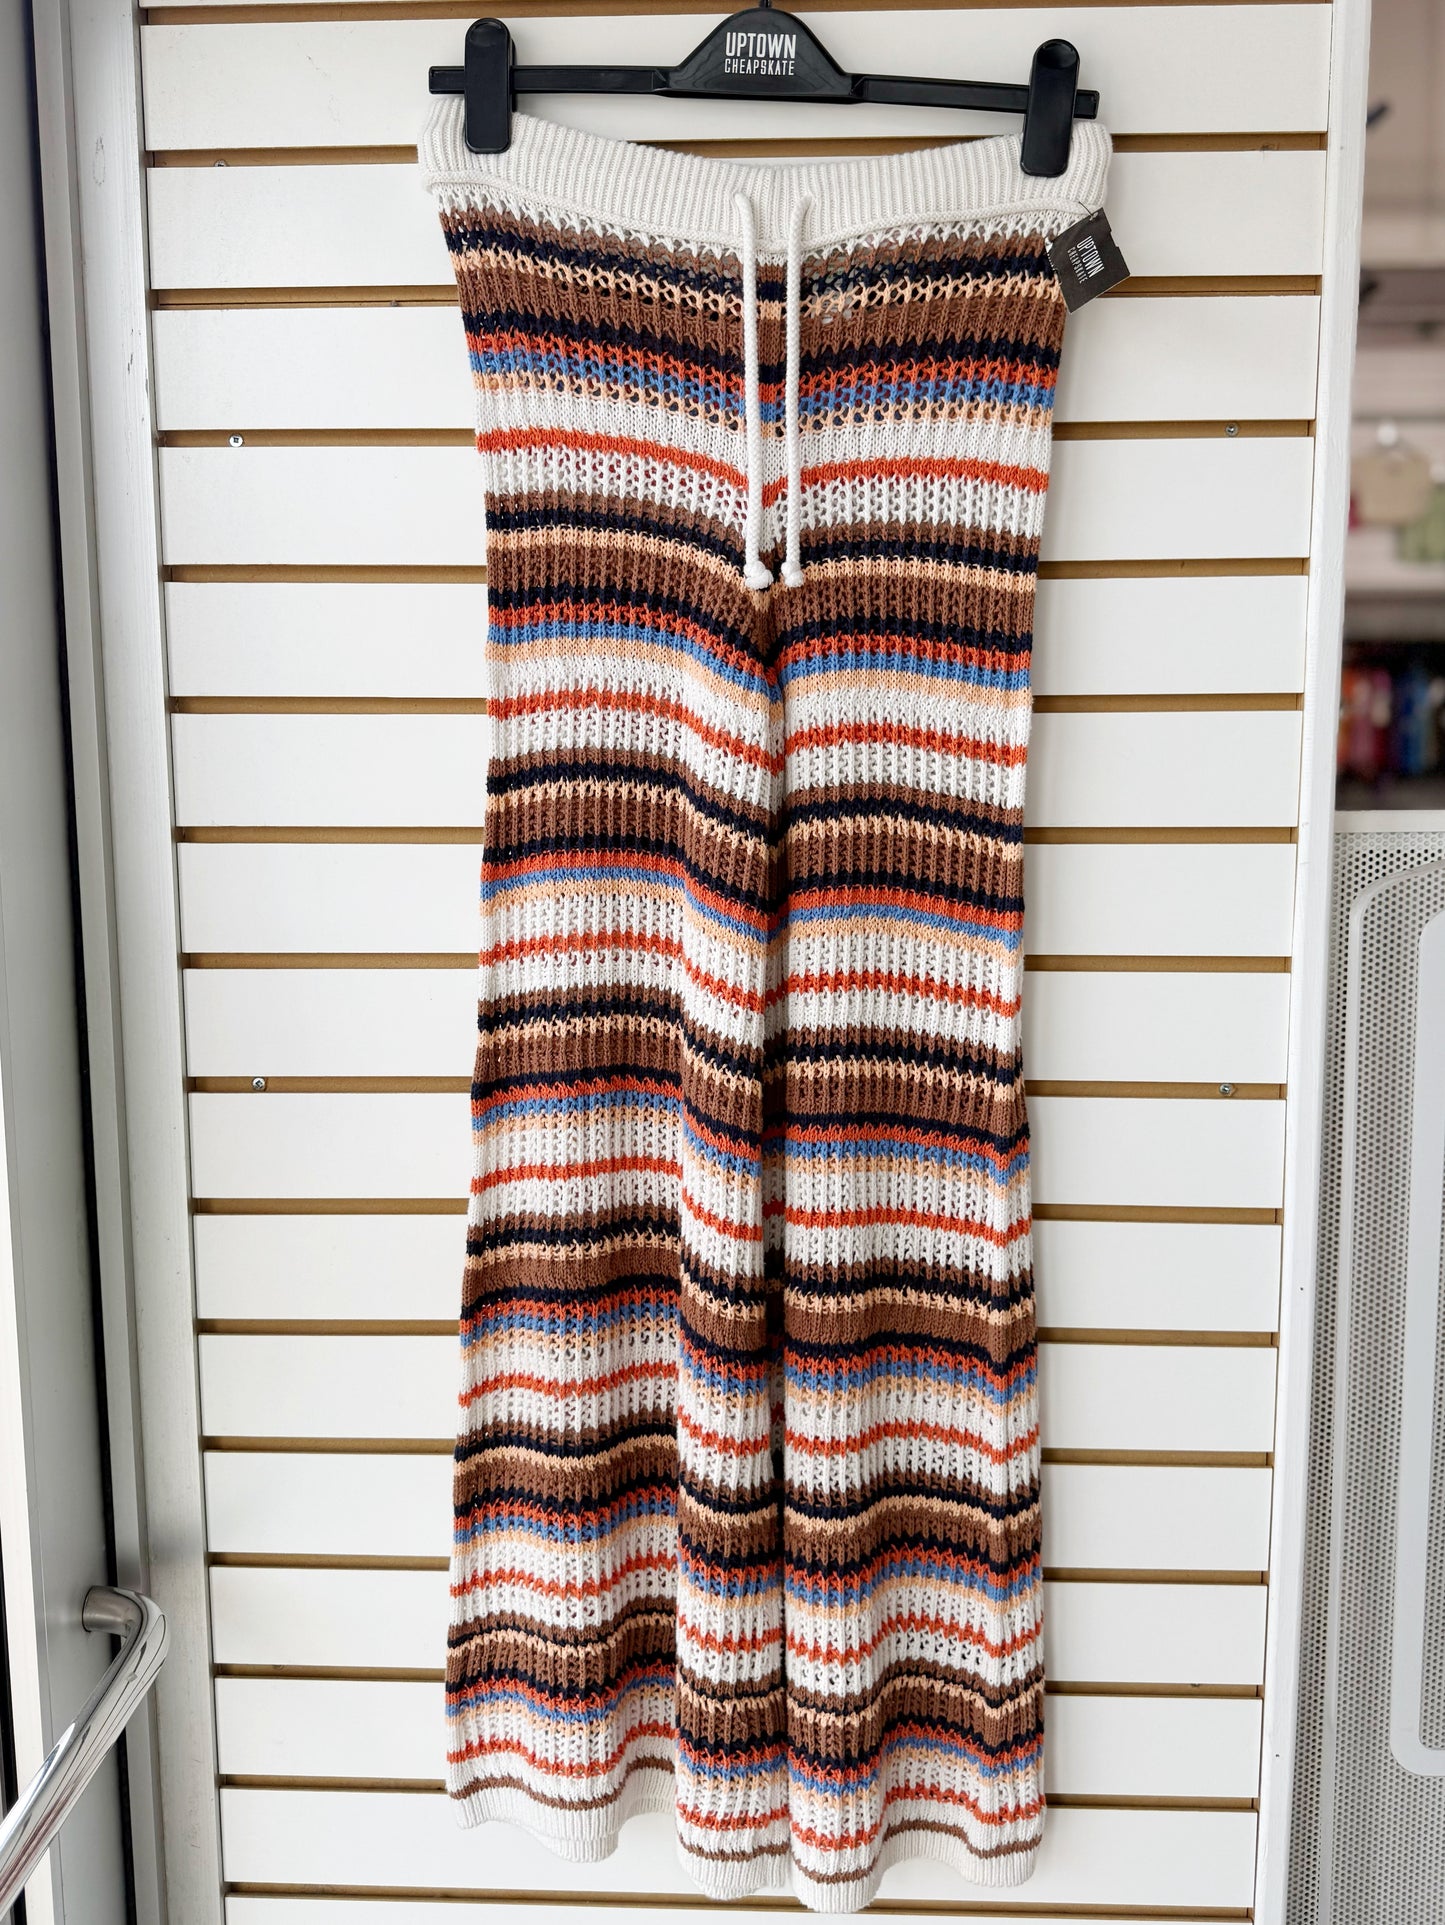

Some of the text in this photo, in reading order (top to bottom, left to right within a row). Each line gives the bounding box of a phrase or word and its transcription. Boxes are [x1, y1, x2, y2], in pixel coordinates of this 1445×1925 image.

[725, 32, 797, 59] UPTOWN
[724, 58, 795, 76] CHEAPSKATE
[1076, 235, 1105, 278] UPTOWN
